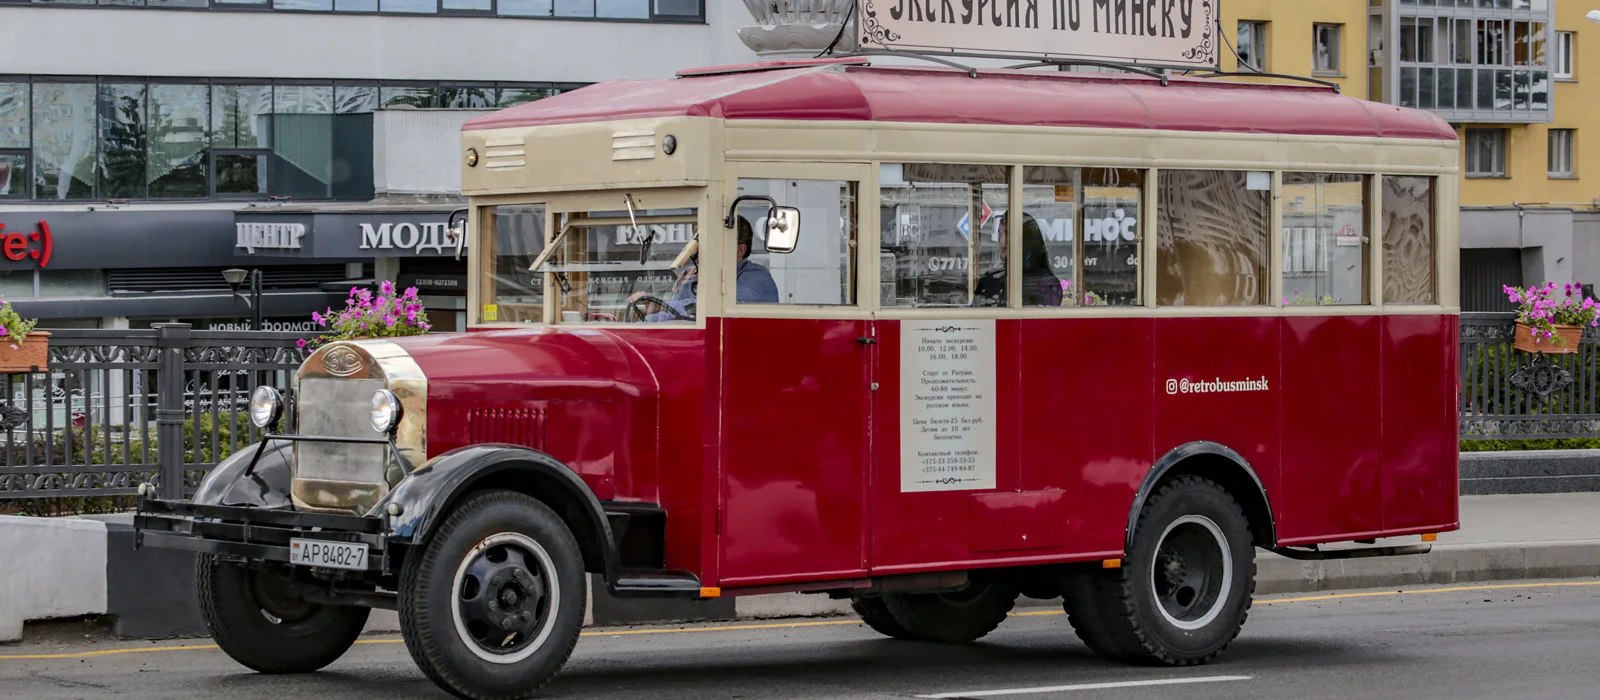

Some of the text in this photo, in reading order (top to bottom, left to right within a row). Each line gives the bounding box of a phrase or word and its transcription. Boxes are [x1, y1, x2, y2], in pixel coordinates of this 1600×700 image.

[235, 222, 305, 254] ЦЕНТР
[1053, 255, 1068, 269] 30
[209, 319, 318, 332] новый формат
[930, 385, 948, 393] 60-80
[1180, 375, 1269, 394] @retrobusminsk
[322, 545, 365, 567] 8482-7
